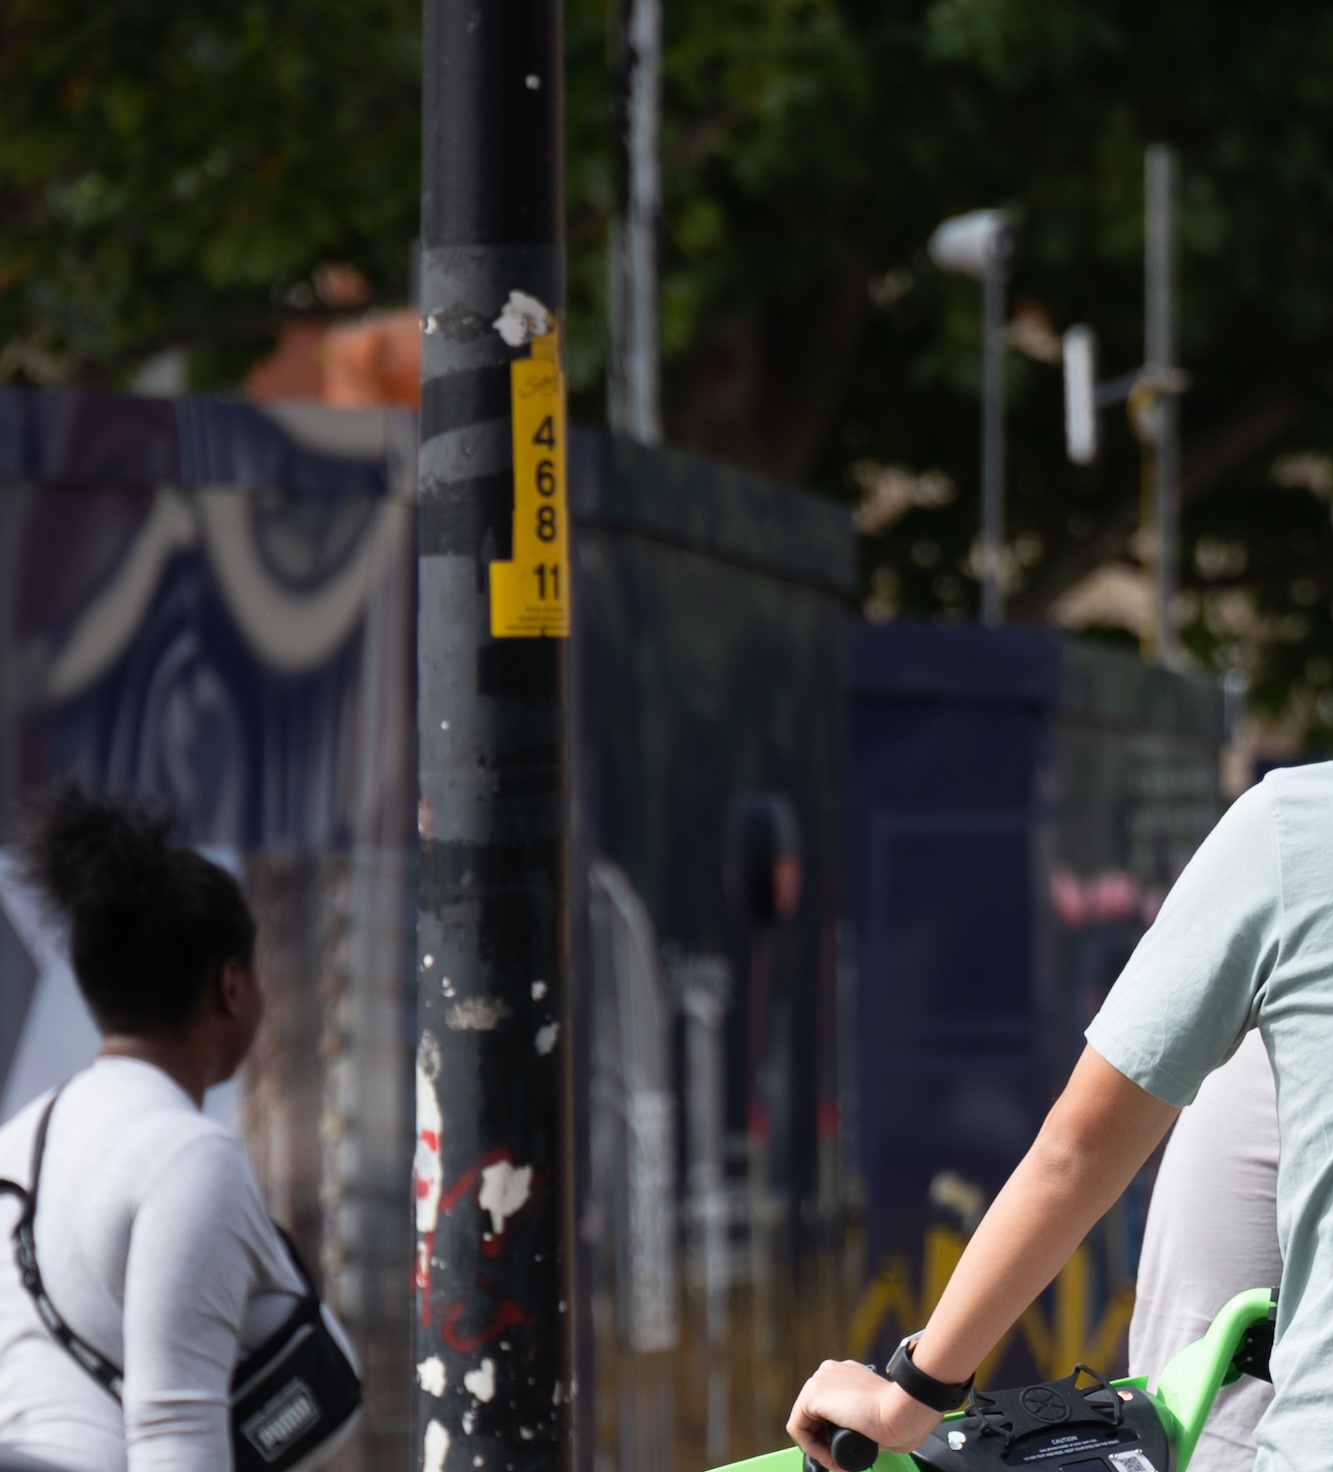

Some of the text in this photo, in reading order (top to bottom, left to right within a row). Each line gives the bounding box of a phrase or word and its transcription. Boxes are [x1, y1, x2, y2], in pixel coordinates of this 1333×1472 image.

[532, 414, 555, 452] 4
[535, 459, 556, 497] 6
[535, 506, 556, 543] 8
[533, 562, 561, 601] 11
